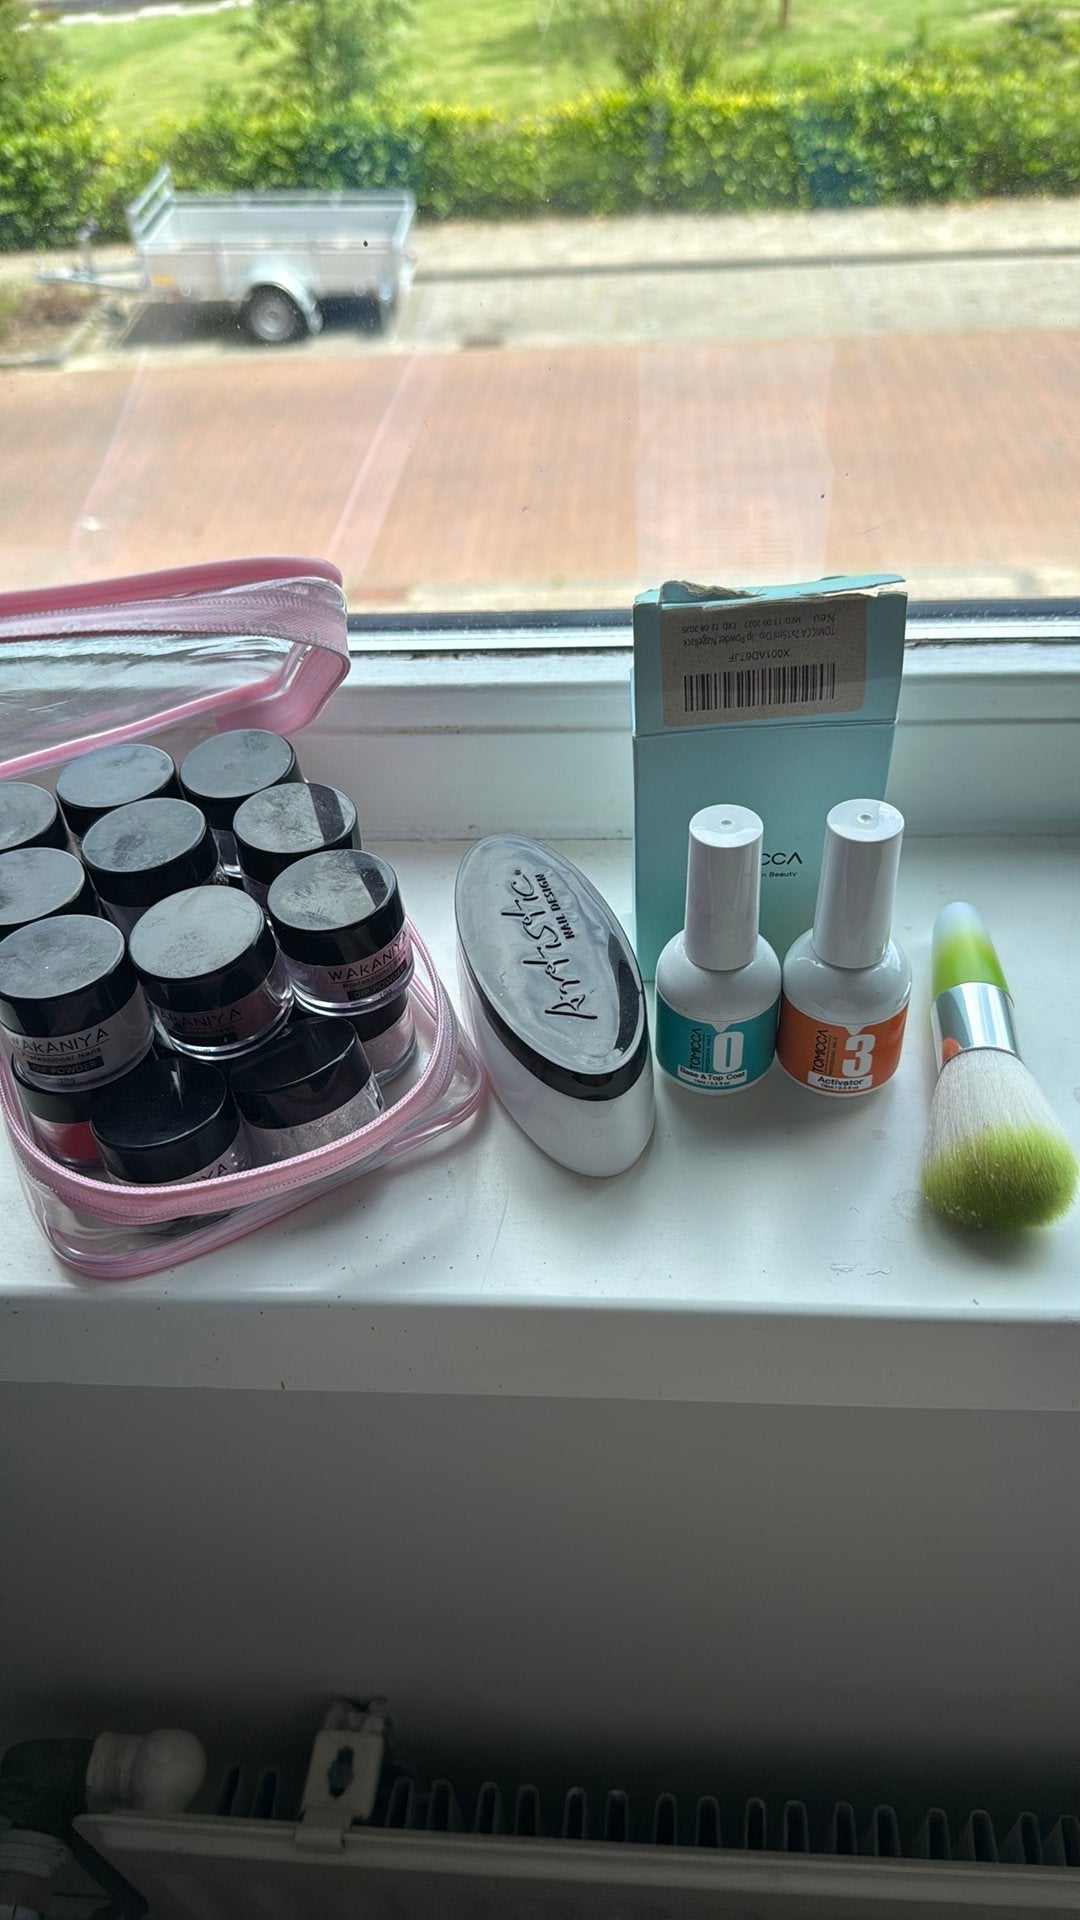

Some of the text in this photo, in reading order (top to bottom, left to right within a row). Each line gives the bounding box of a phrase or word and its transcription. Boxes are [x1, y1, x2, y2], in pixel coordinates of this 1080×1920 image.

[813, 614, 835, 624] Neu
[535, 873, 576, 940] NAIL DESIGN
[327, 930, 407, 981] WAKANIYA
[713, 1031, 744, 1073] 0
[842, 1034, 876, 1077] 3
[680, 1066, 699, 1079] Base
[707, 1074, 723, 1082] Top
[726, 1071, 746, 1081] Coat
[817, 1076, 864, 1087] Activator
